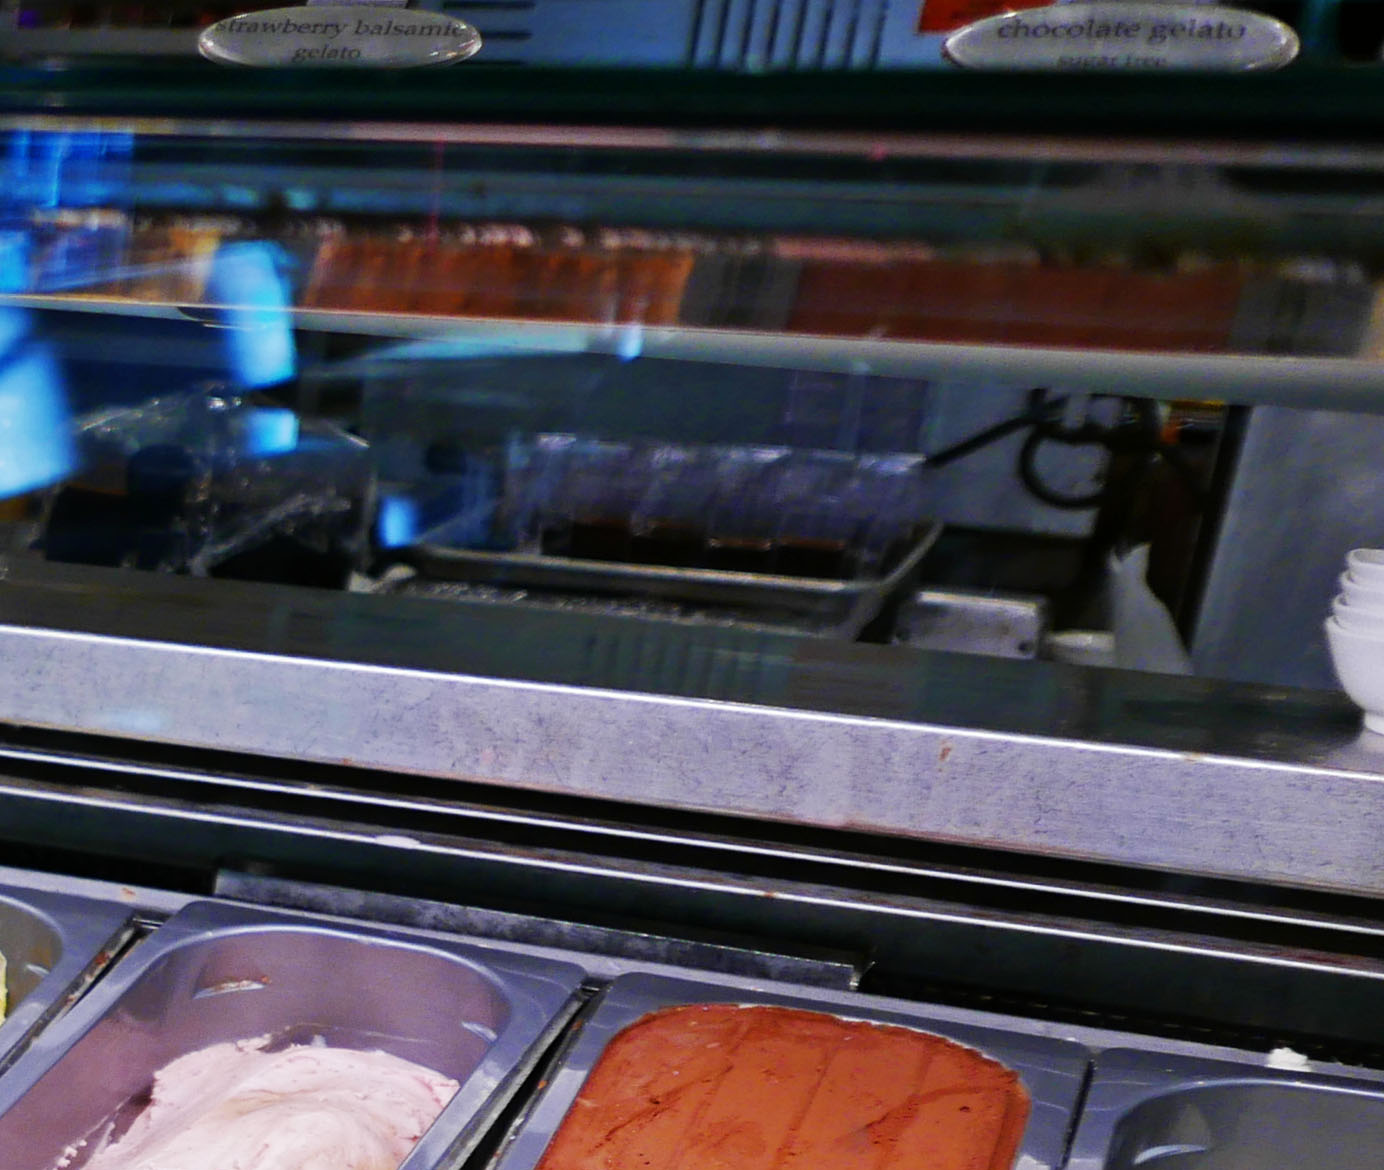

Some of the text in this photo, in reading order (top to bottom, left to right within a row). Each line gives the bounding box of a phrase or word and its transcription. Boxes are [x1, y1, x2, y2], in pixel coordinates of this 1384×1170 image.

[214, 18, 470, 38] strawberry balsamic
[996, 17, 1248, 43] chocolate gelato
[290, 44, 362, 64] gelato
